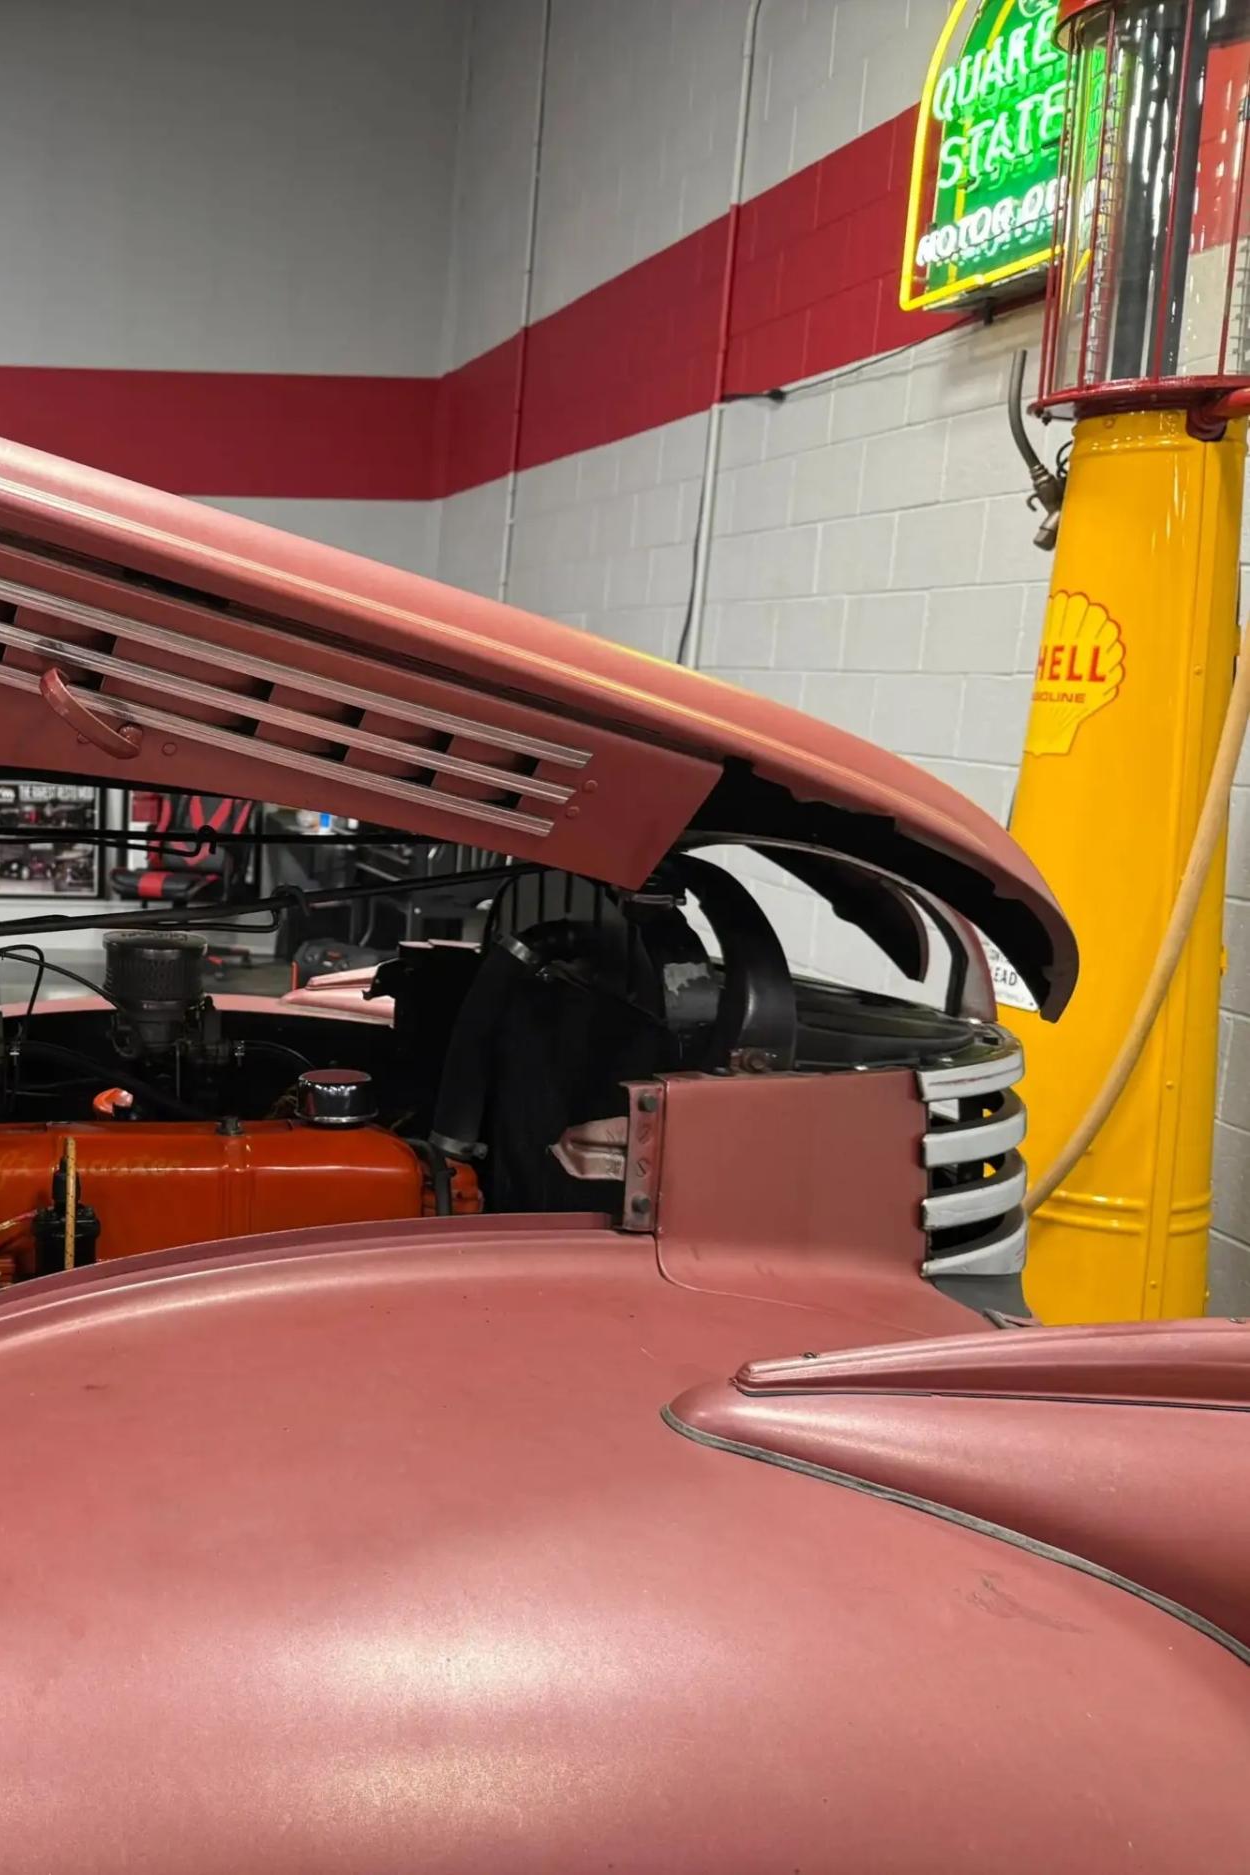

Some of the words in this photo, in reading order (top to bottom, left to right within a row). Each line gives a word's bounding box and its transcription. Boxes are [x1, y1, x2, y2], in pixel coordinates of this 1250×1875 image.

[932, 5, 1059, 121] QUAKE
[938, 80, 1071, 188] STATE
[916, 196, 1014, 266] MOTOR
[1037, 645, 1106, 682] HELL
[993, 966, 1018, 986] EAD
